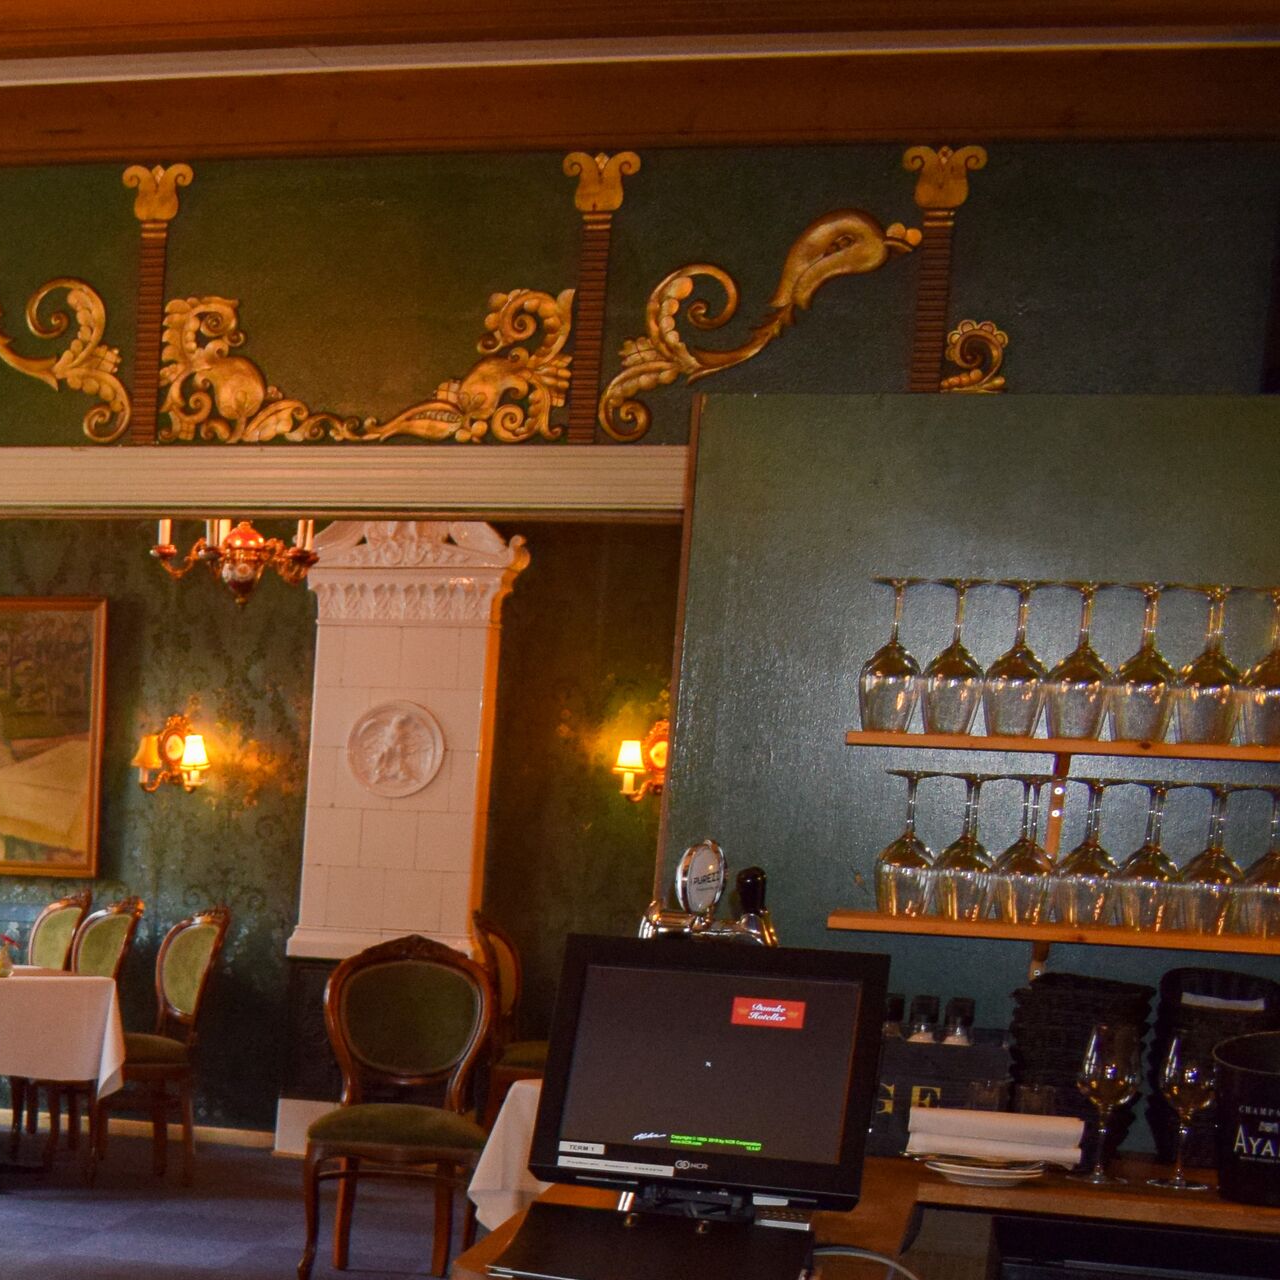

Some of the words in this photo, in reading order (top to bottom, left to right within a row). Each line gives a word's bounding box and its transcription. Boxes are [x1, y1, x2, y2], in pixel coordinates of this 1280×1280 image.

[752, 1003, 786, 1013] Danske
[748, 1011, 786, 1021] Hoteller
[1233, 1124, 1280, 1157] AYA
